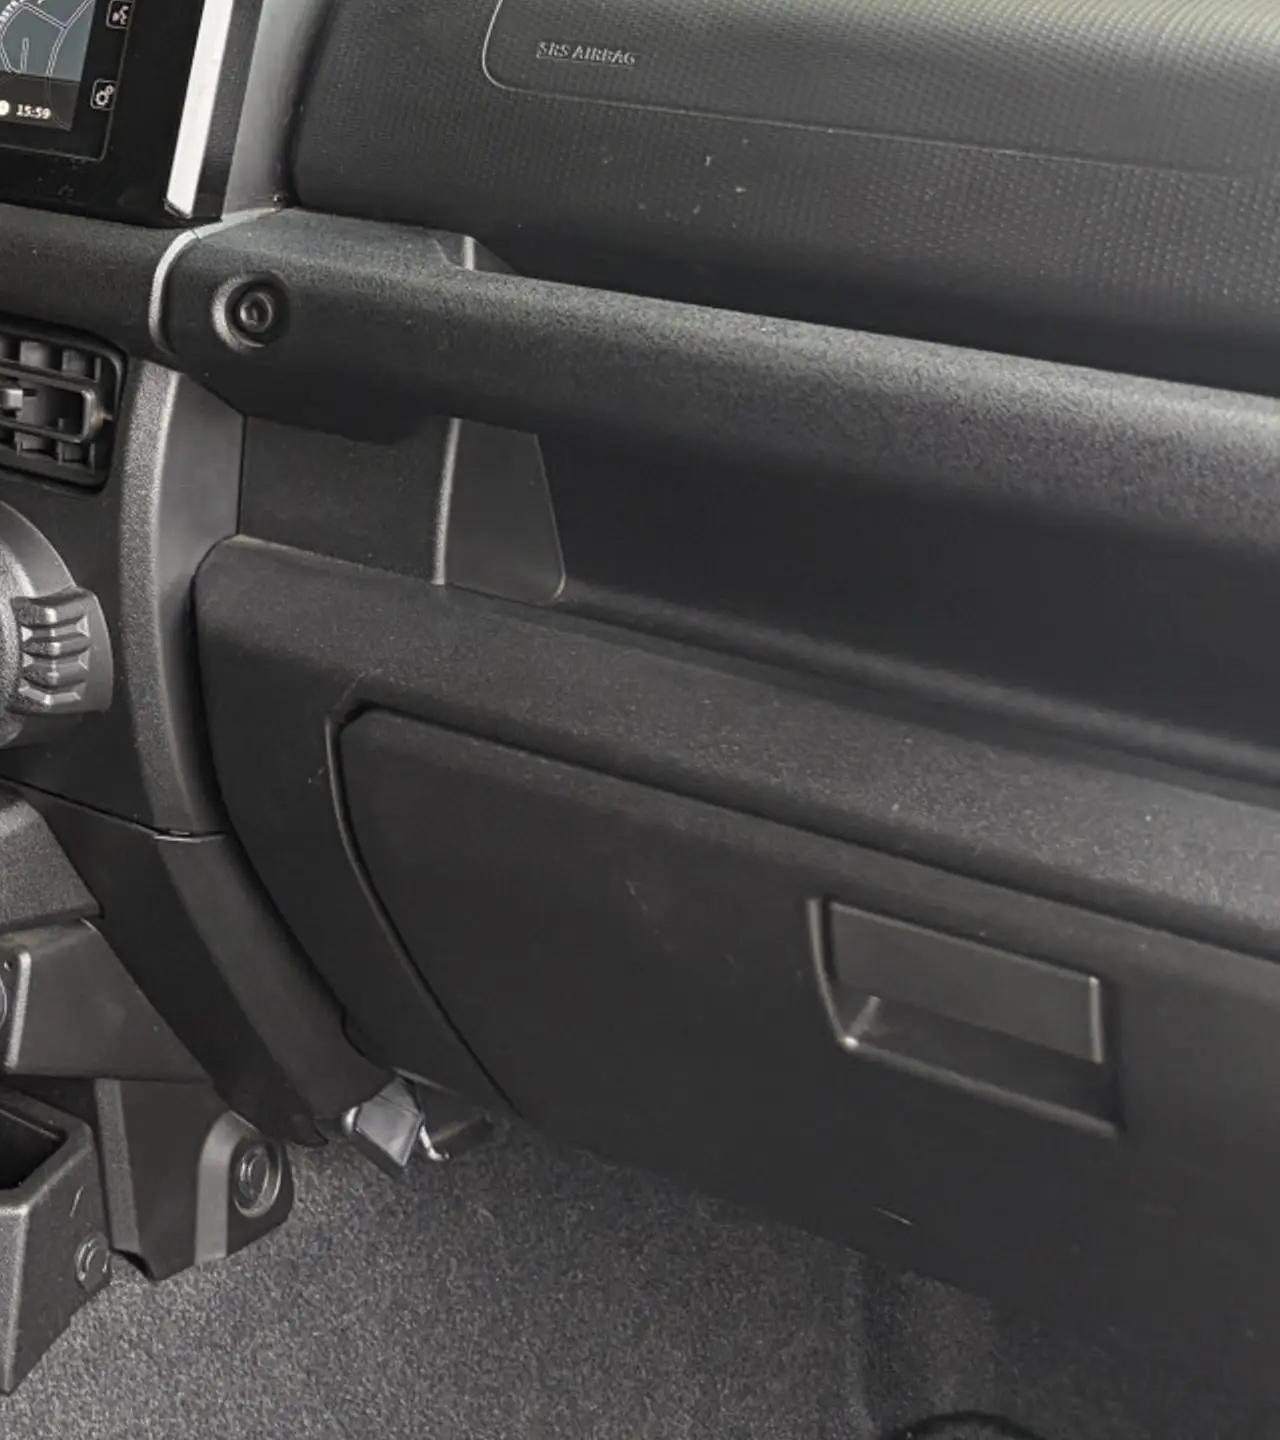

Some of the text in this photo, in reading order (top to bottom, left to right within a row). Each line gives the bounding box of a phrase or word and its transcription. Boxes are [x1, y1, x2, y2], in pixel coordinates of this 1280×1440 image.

[536, 41, 636, 65] SRS AIRBAG
[15, 103, 52, 120] 15:59
